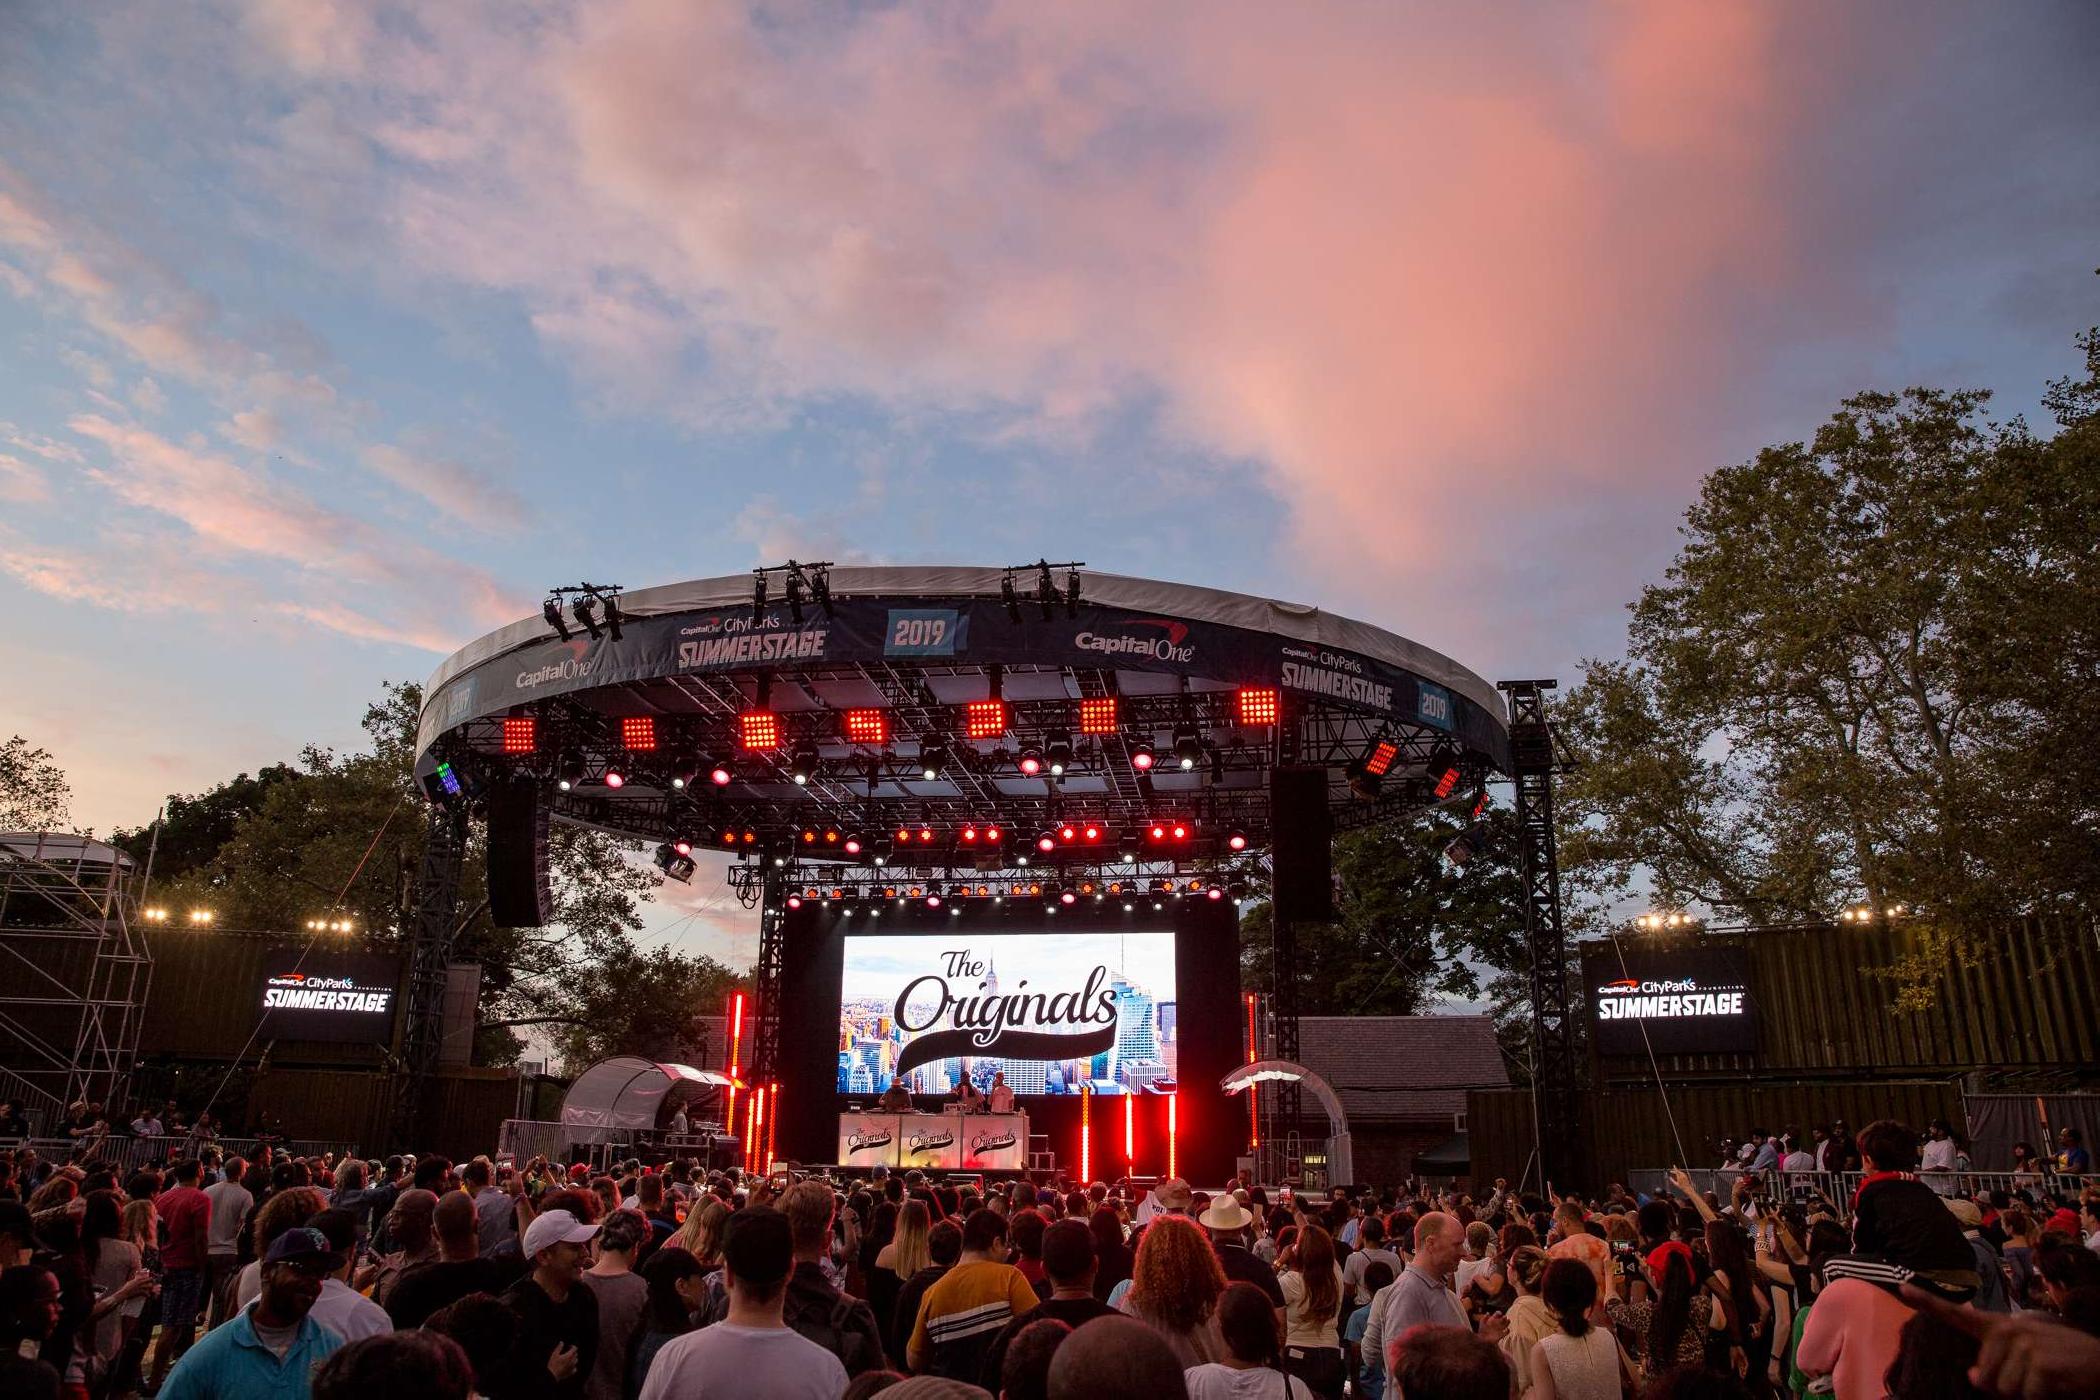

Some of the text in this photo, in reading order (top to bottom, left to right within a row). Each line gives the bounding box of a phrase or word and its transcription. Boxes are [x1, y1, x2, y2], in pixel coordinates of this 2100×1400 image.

[894, 619, 946, 646] 2019
[678, 630, 827, 668] SUMMERSTAGE
[1320, 652, 1362, 673] CityParks
[1281, 661, 1393, 711] SUMMERSTAGE
[1422, 693, 1446, 721] 2019
[940, 949, 985, 978] The
[306, 977, 353, 990] CityParks
[1641, 980, 1696, 995] CityParks
[264, 988, 389, 1012] SUMMERSTAGE
[894, 965, 1118, 1046] Originals
[1599, 993, 1743, 1020] SUMMERSTAGE
